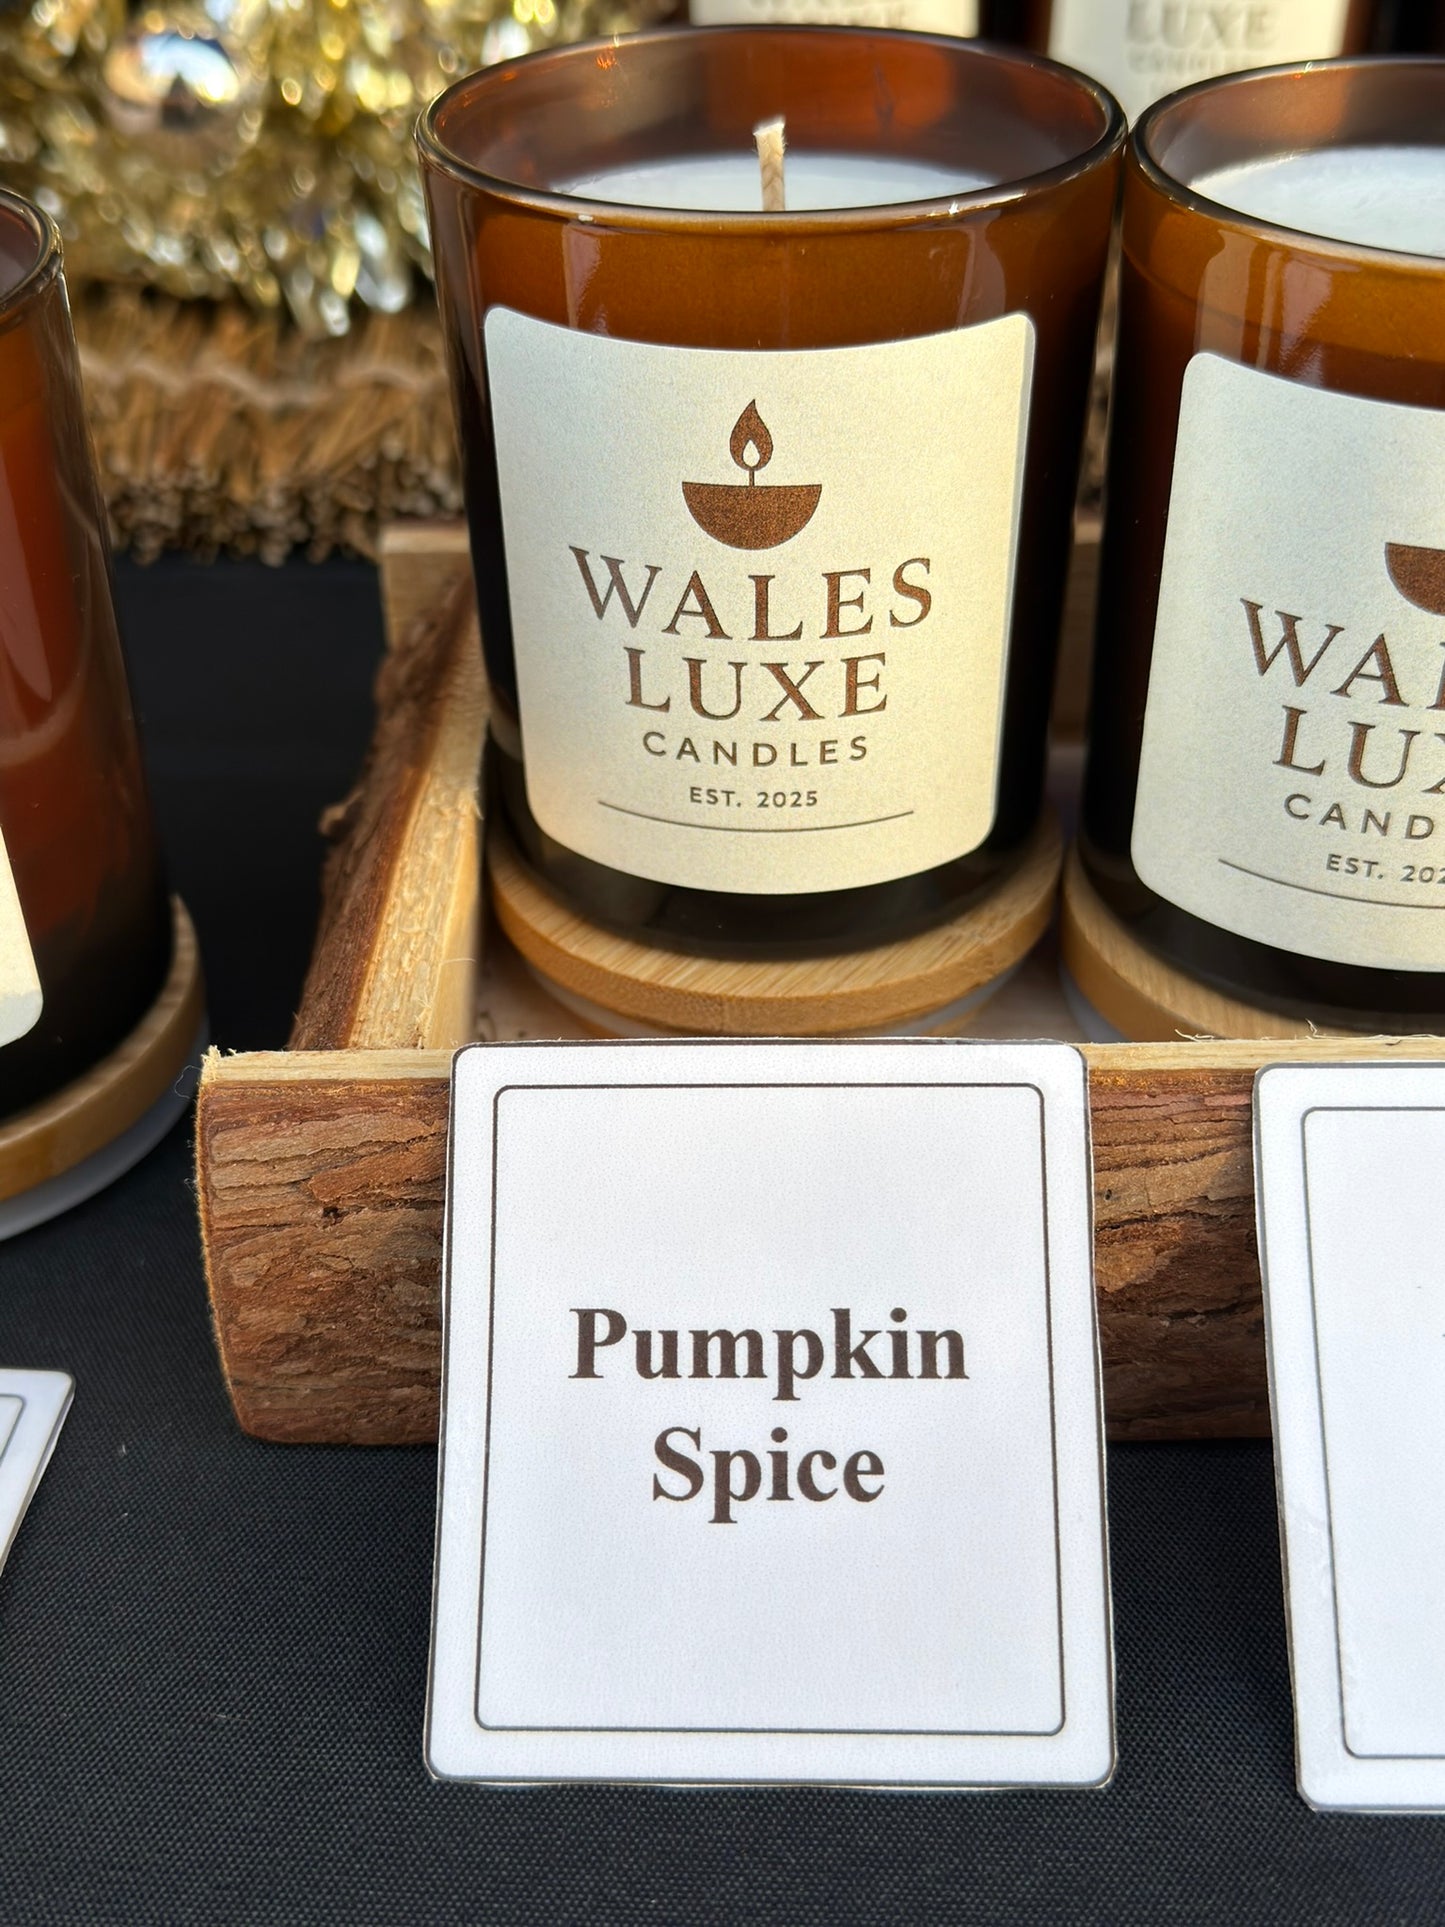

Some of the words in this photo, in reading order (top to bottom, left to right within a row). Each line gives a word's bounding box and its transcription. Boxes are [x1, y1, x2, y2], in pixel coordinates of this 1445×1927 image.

[567, 545, 933, 641] WALES
[622, 646, 888, 722] LUXE
[642, 730, 868, 768] CANDLES
[689, 786, 742, 808] EST.
[757, 790, 819, 808] 2025
[1325, 853, 1384, 880] EST.
[568, 1307, 970, 1401] Pumpkin
[653, 1427, 886, 1524] Spice
